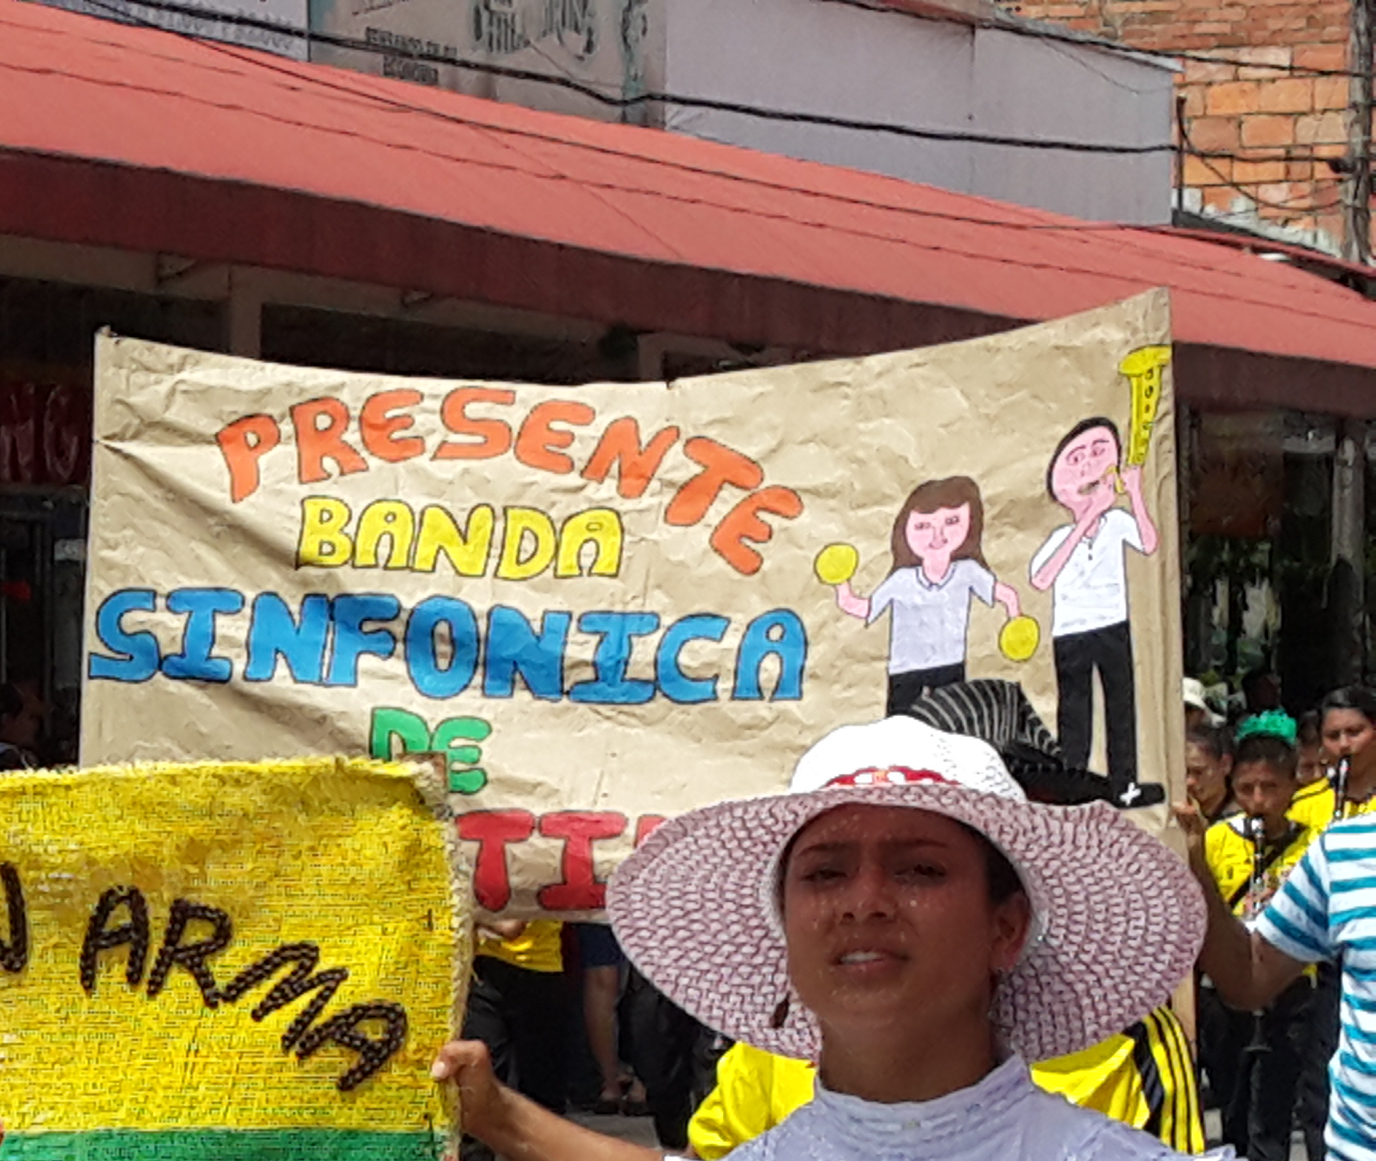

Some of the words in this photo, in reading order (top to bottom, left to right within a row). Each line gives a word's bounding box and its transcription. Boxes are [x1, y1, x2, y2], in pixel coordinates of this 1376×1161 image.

[213, 387, 805, 577] PRESENTE
[295, 496, 626, 581] BANDA
[87, 586, 810, 705] SINFONICA
[369, 706, 493, 794] DE
[454, 807, 668, 912] TI
[78, 885, 410, 1093] ARMA
